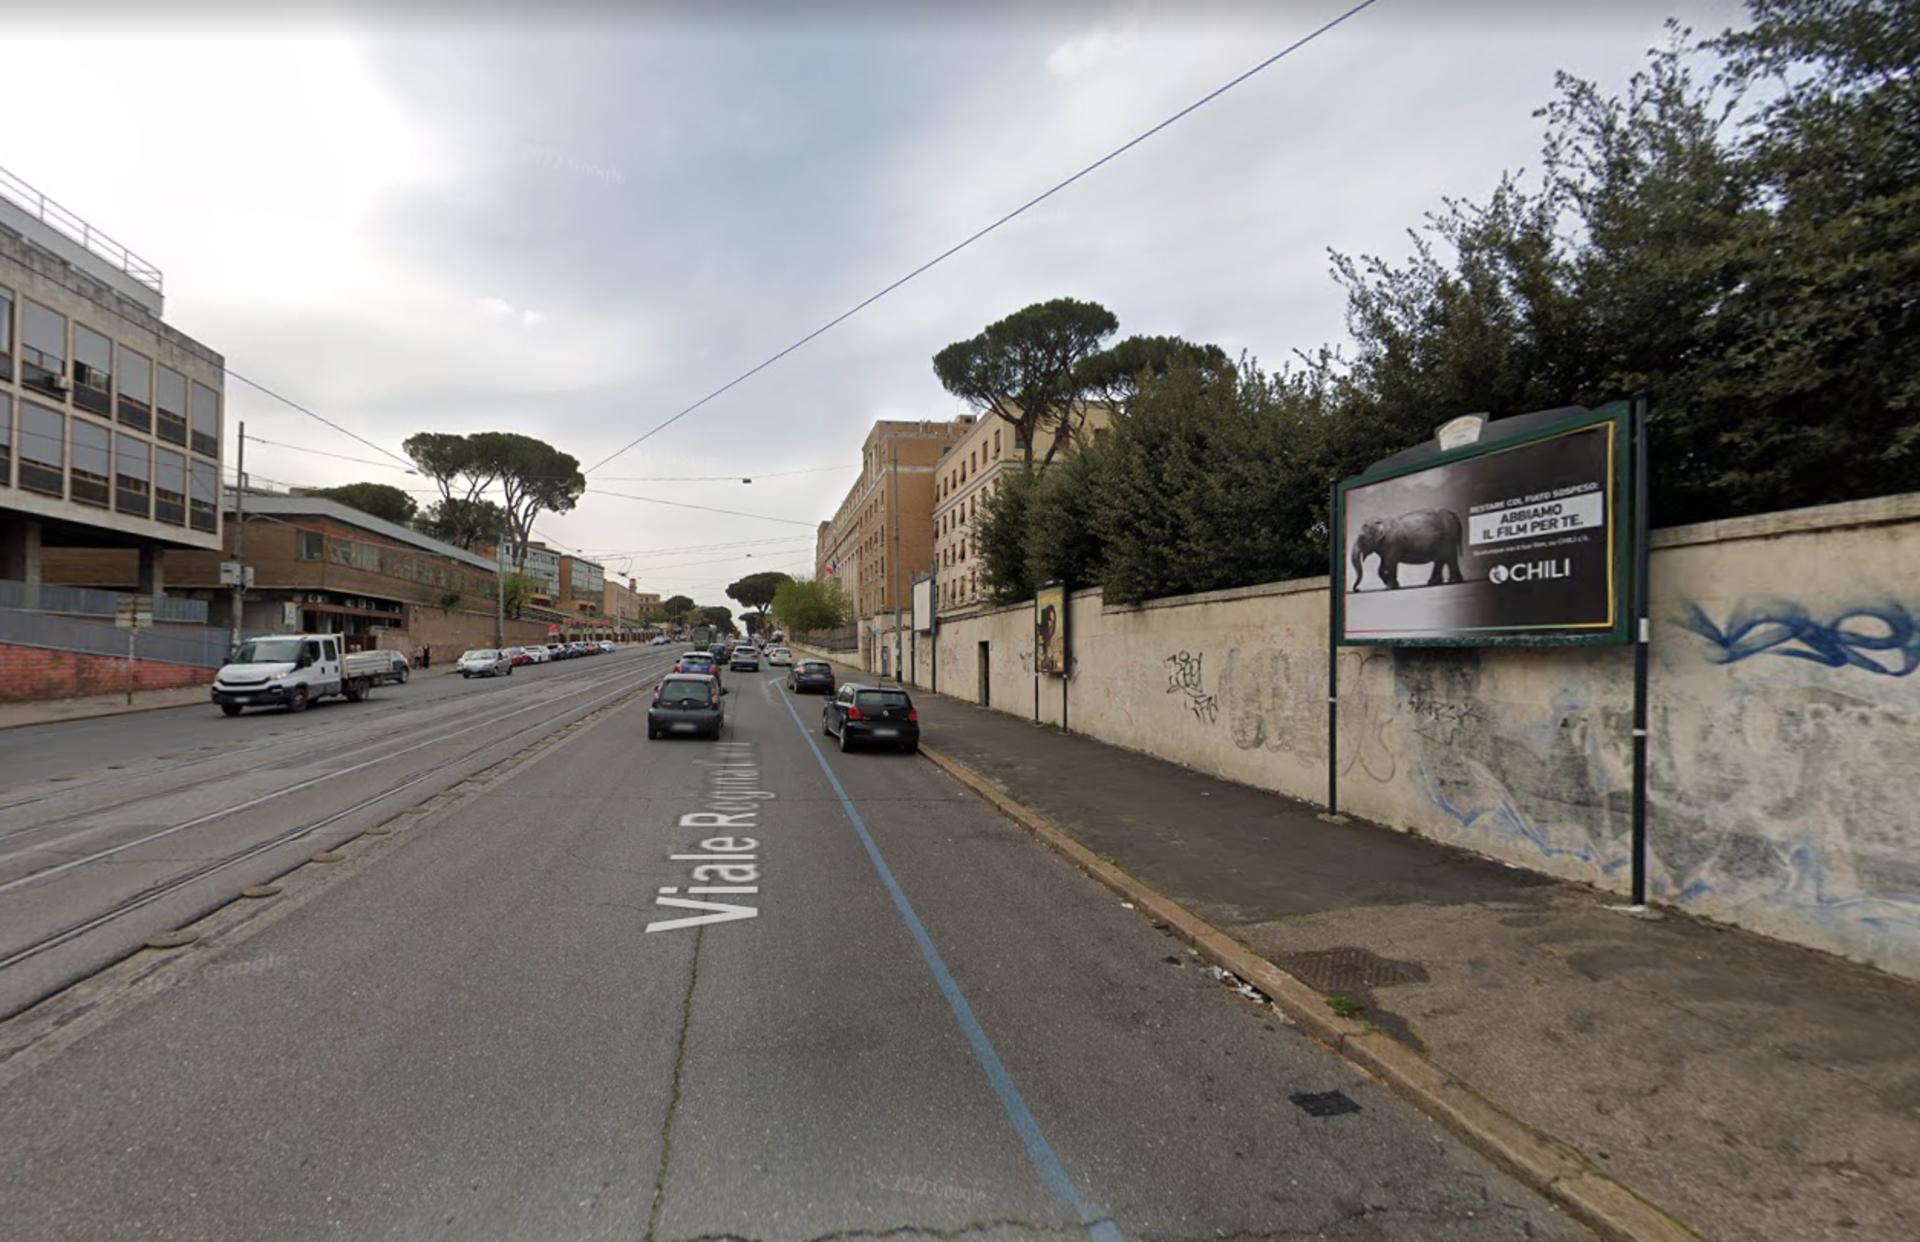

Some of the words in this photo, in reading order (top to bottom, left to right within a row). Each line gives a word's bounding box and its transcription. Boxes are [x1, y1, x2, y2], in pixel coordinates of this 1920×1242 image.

[1469, 500, 1505, 514] RESTARE
[1506, 498, 1524, 507] COL
[1524, 491, 1551, 503] FIATO
[1500, 503, 1562, 525] ABBIAMO
[1482, 528, 1493, 540] IL
[1496, 522, 1527, 539] FILM
[1530, 517, 1557, 533] PER
[1560, 513, 1584, 528] TE.
[1510, 557, 1571, 582] CHILI
